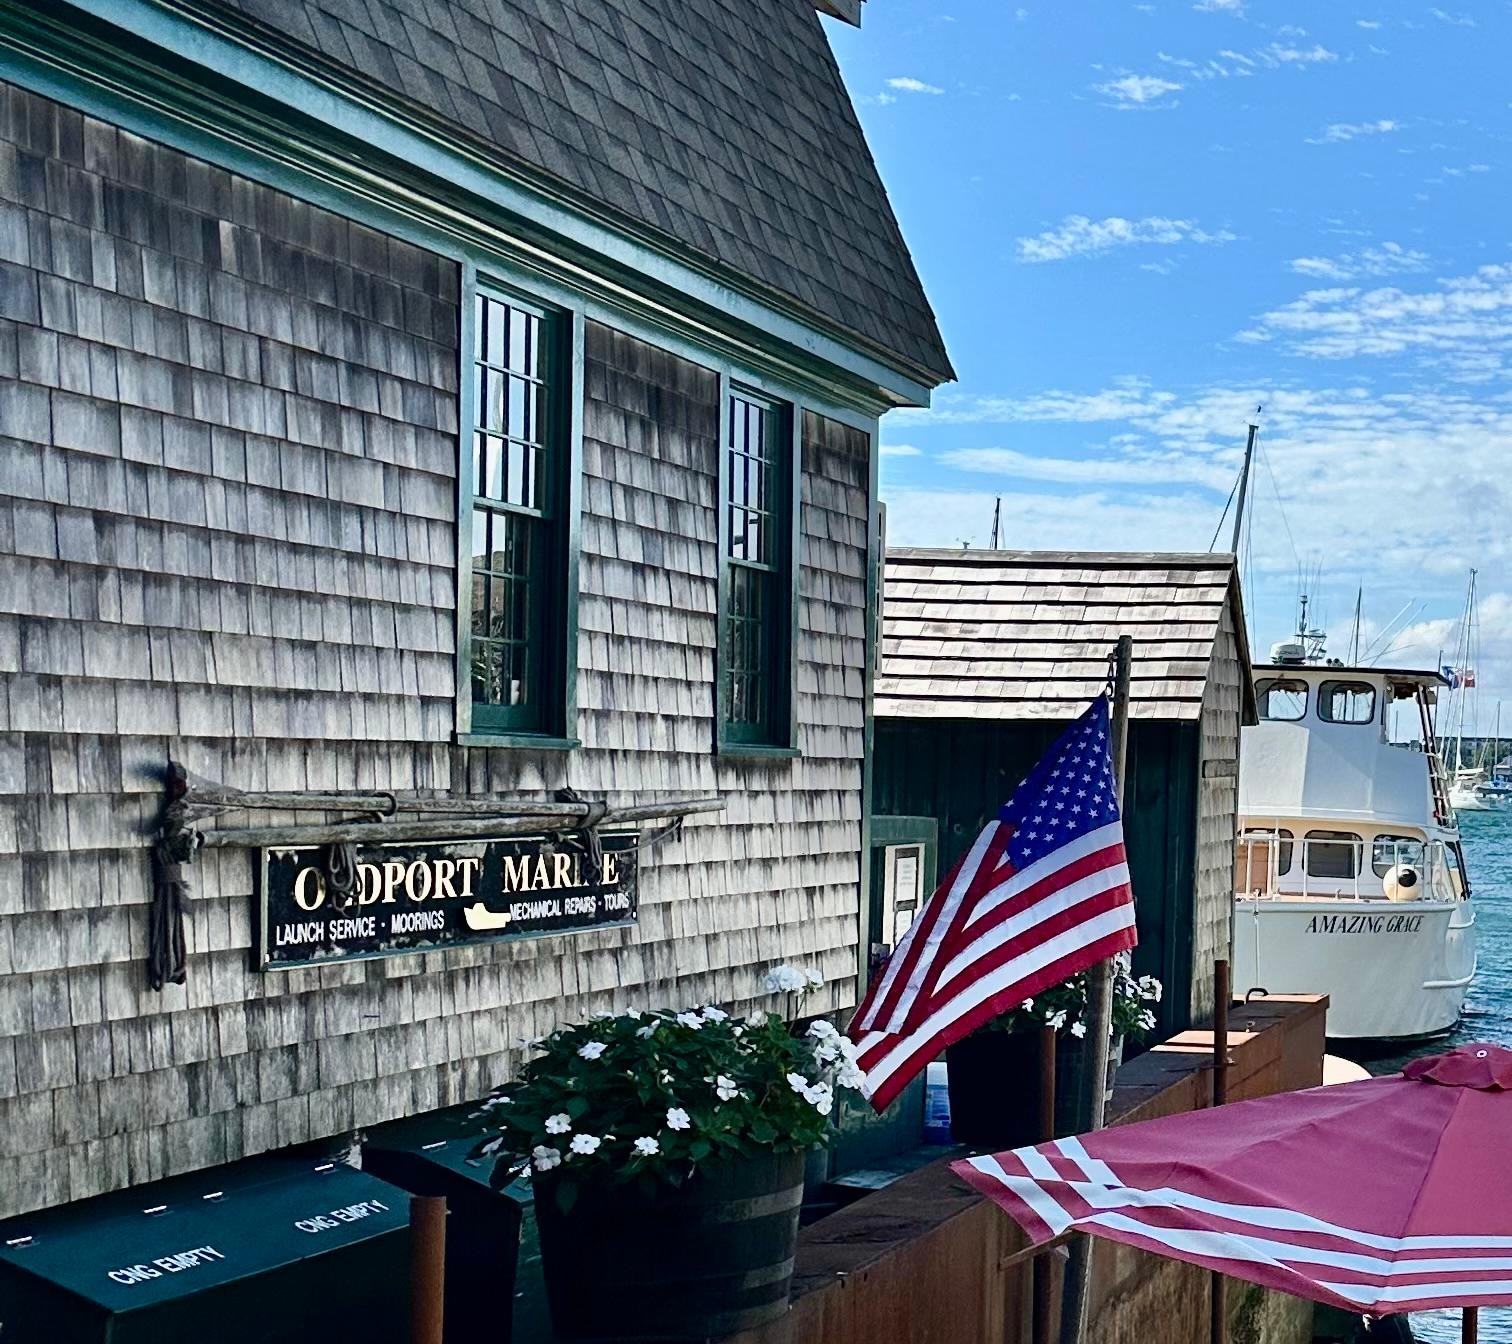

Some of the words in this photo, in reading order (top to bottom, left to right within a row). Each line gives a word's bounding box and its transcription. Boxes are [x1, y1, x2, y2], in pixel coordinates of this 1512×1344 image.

[276, 920, 324, 946] LAUNCH
[329, 916, 376, 941] SERVICE
[391, 909, 445, 934] MOORINGS
[509, 898, 562, 921] MECHANICAL
[564, 895, 597, 915] REPAIRS
[604, 892, 630, 912] TOURS
[1304, 915, 1386, 934] AMAZING
[1386, 915, 1425, 933] GRACE
[294, 1213, 337, 1234] CNG
[332, 1198, 390, 1224] EMPTY
[107, 1262, 159, 1286] CNG
[152, 1244, 226, 1274] EMPTY
